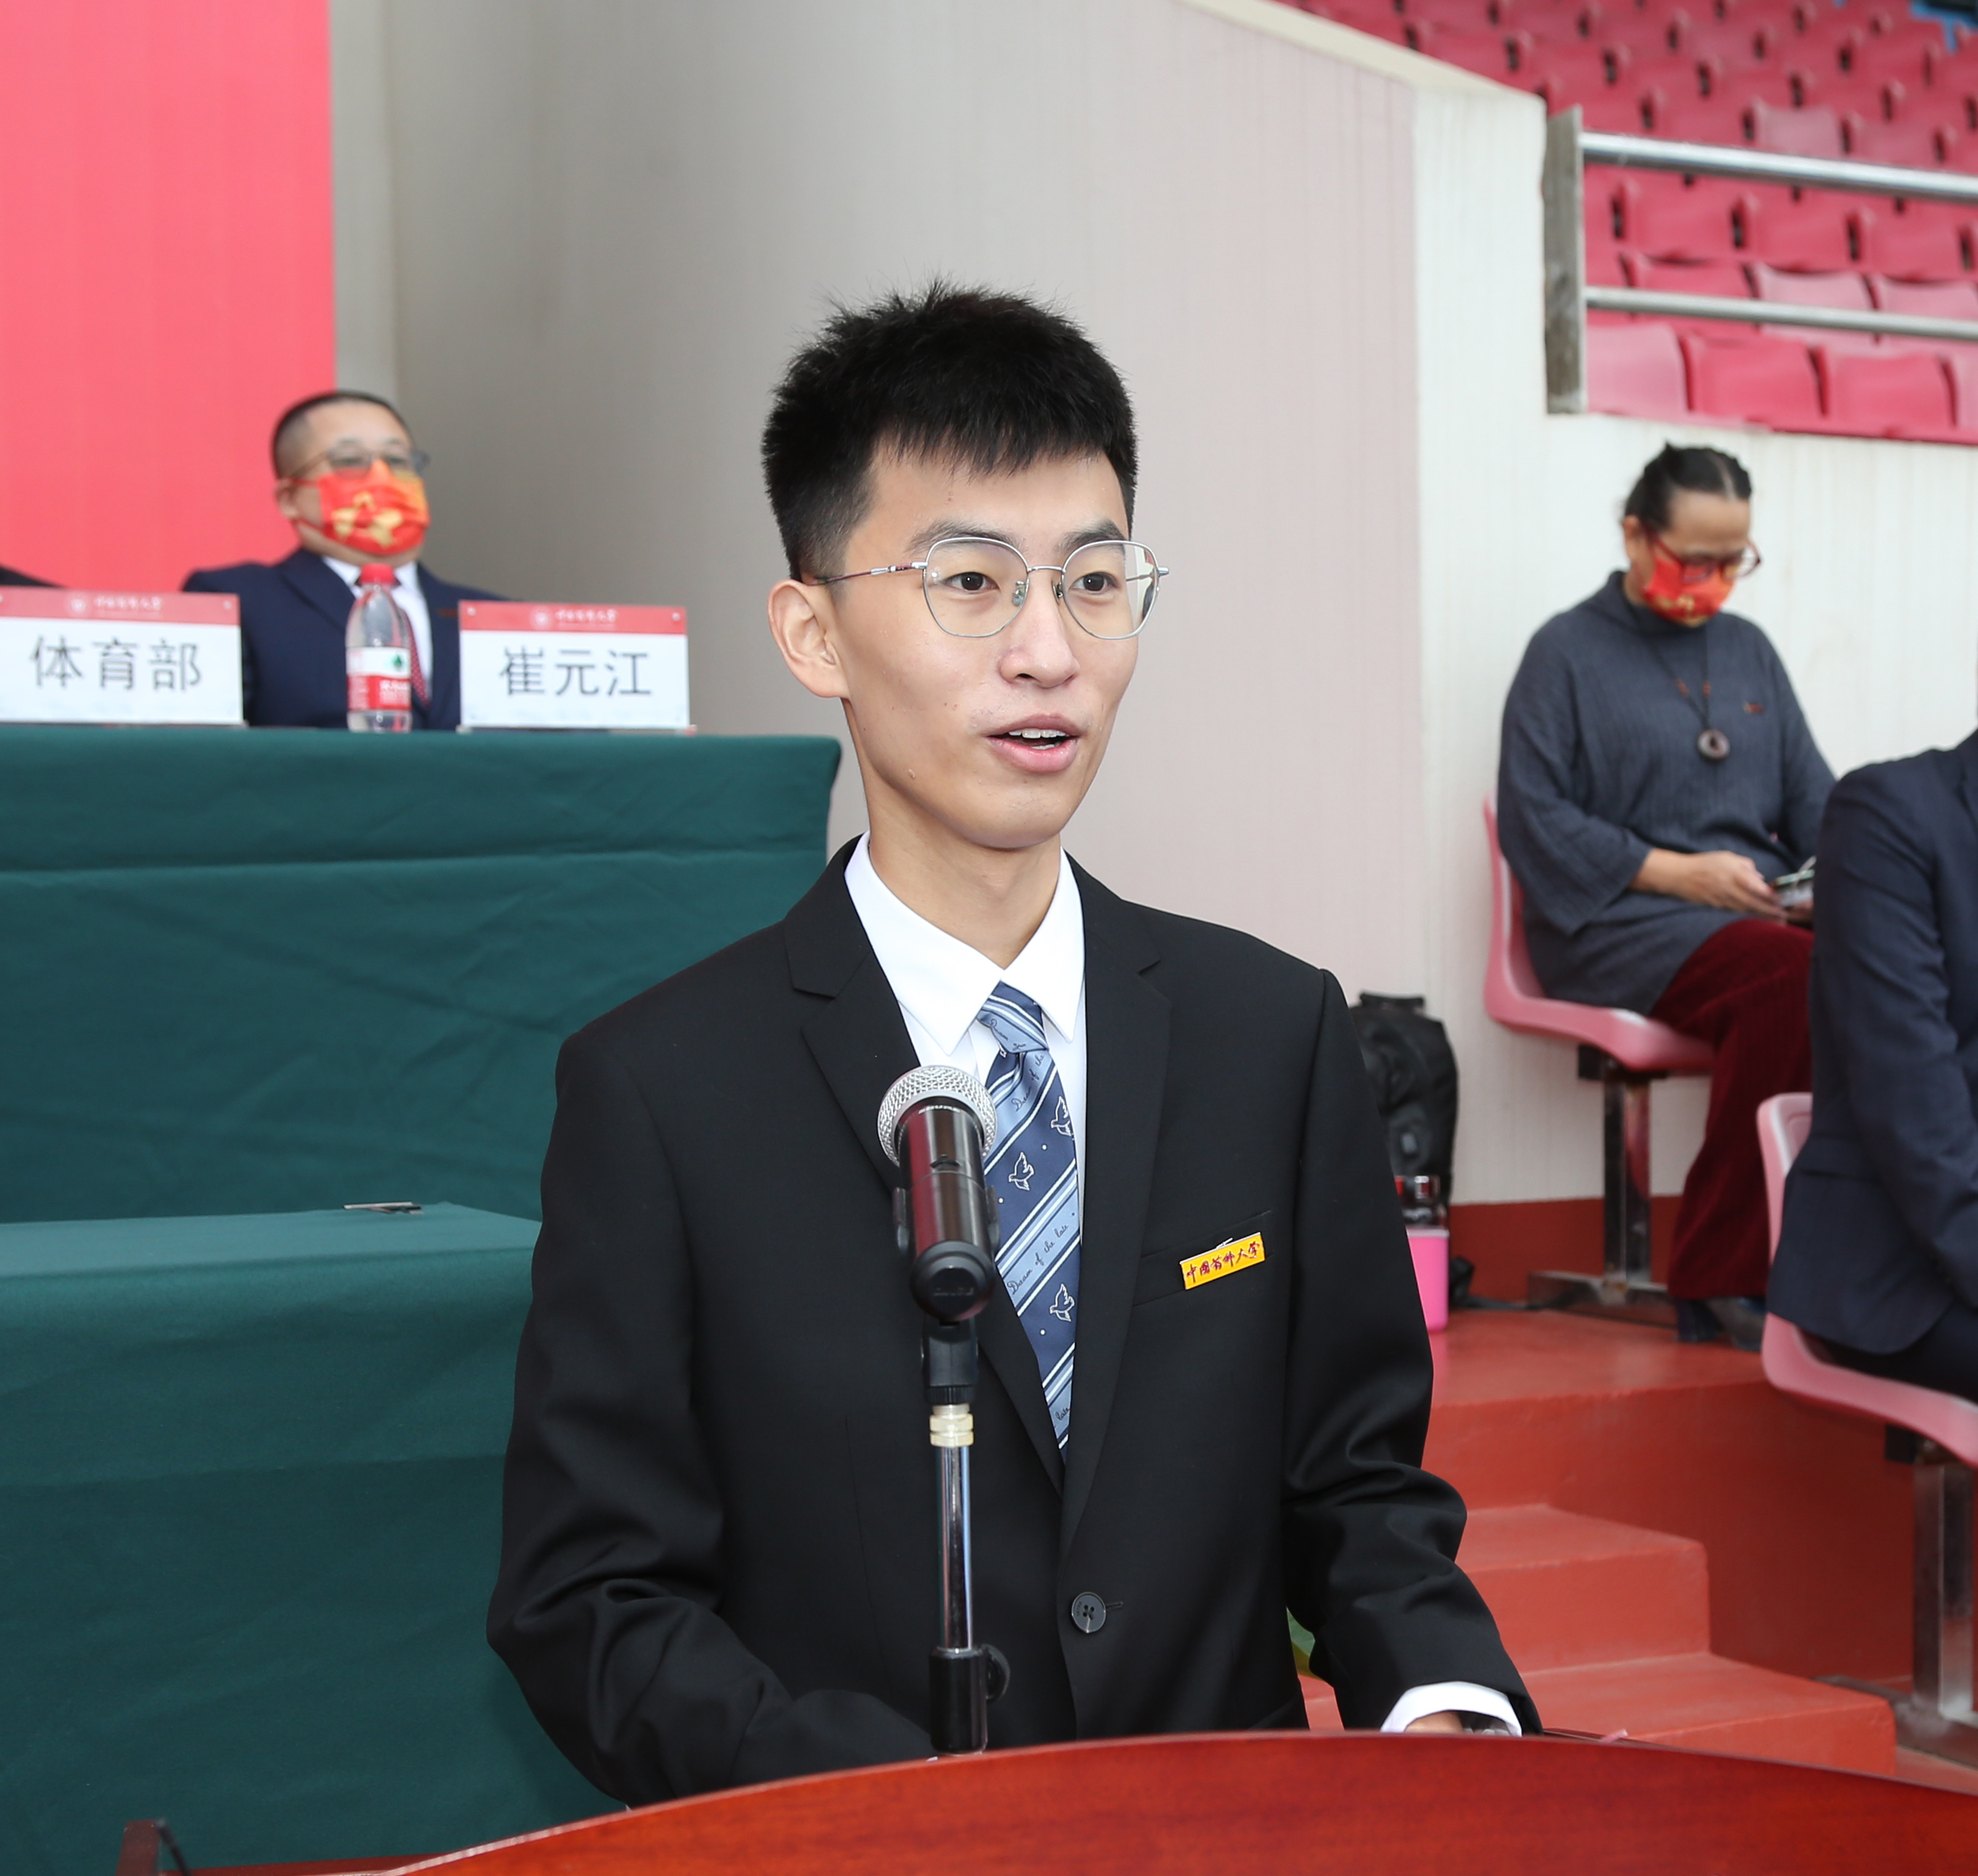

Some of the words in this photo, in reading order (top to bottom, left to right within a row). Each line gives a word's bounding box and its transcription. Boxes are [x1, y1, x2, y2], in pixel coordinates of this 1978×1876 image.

[30, 635, 202, 691] 体育部
[499, 645, 652, 697] 崔元江
[1011, 1086, 1032, 1112] Dream
[1006, 1268, 1033, 1295] Dream
[1035, 1253, 1044, 1266] of
[1043, 1240, 1055, 1253] the
